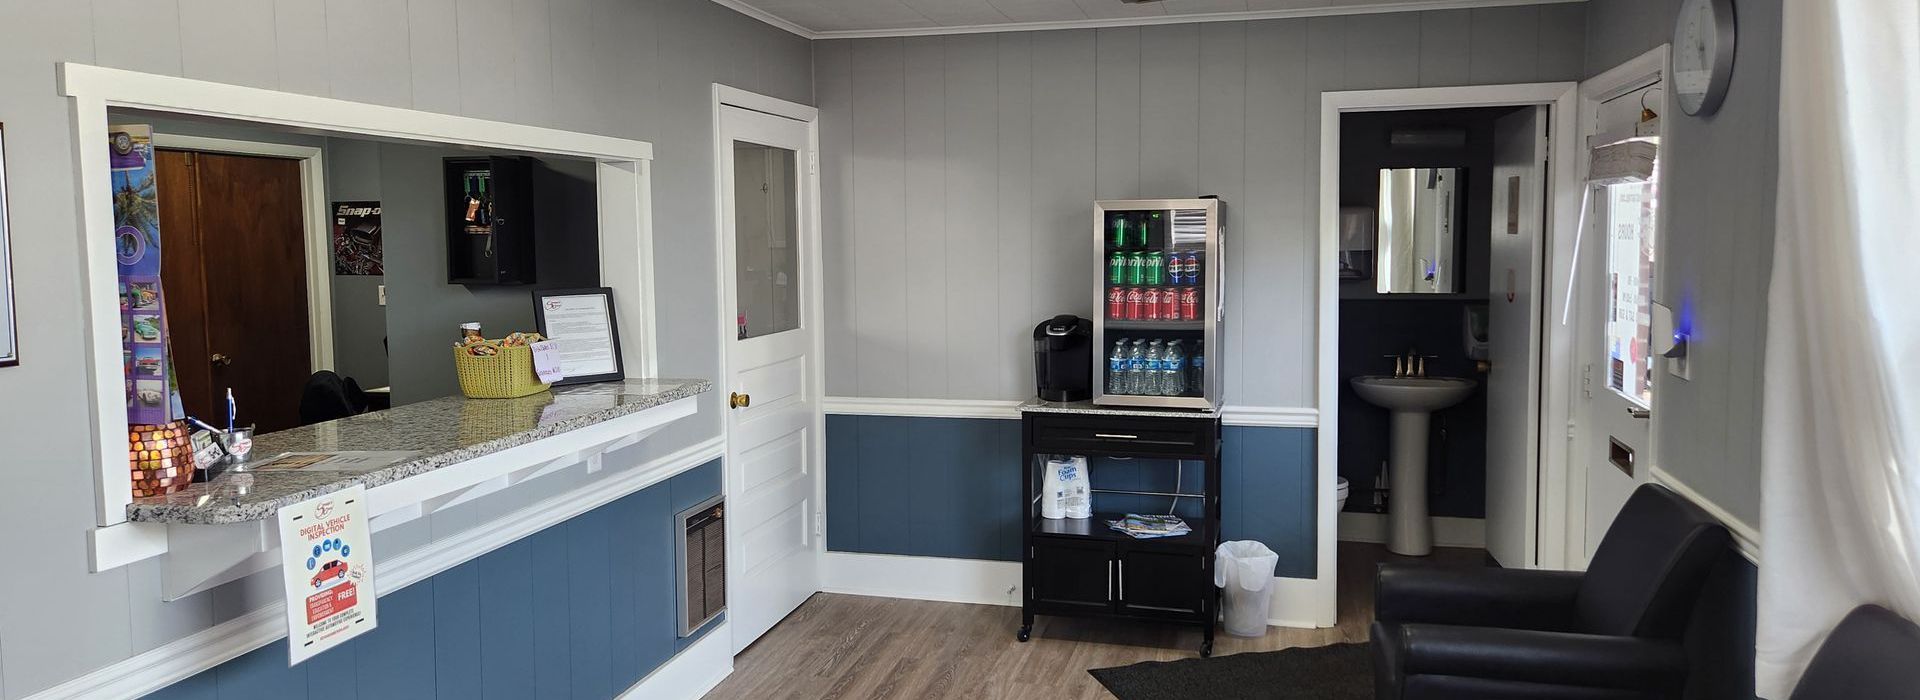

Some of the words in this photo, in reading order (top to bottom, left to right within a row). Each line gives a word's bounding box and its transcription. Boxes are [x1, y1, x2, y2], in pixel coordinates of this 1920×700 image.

[337, 205, 382, 217] Snap-o
[1058, 466, 1077, 476] Foam
[1059, 473, 1077, 482] Cups
[300, 522, 323, 536] DIGITAL
[325, 513, 350, 527] VEHICLE
[307, 523, 344, 540] INSPECTION
[337, 587, 355, 601] FREE!
